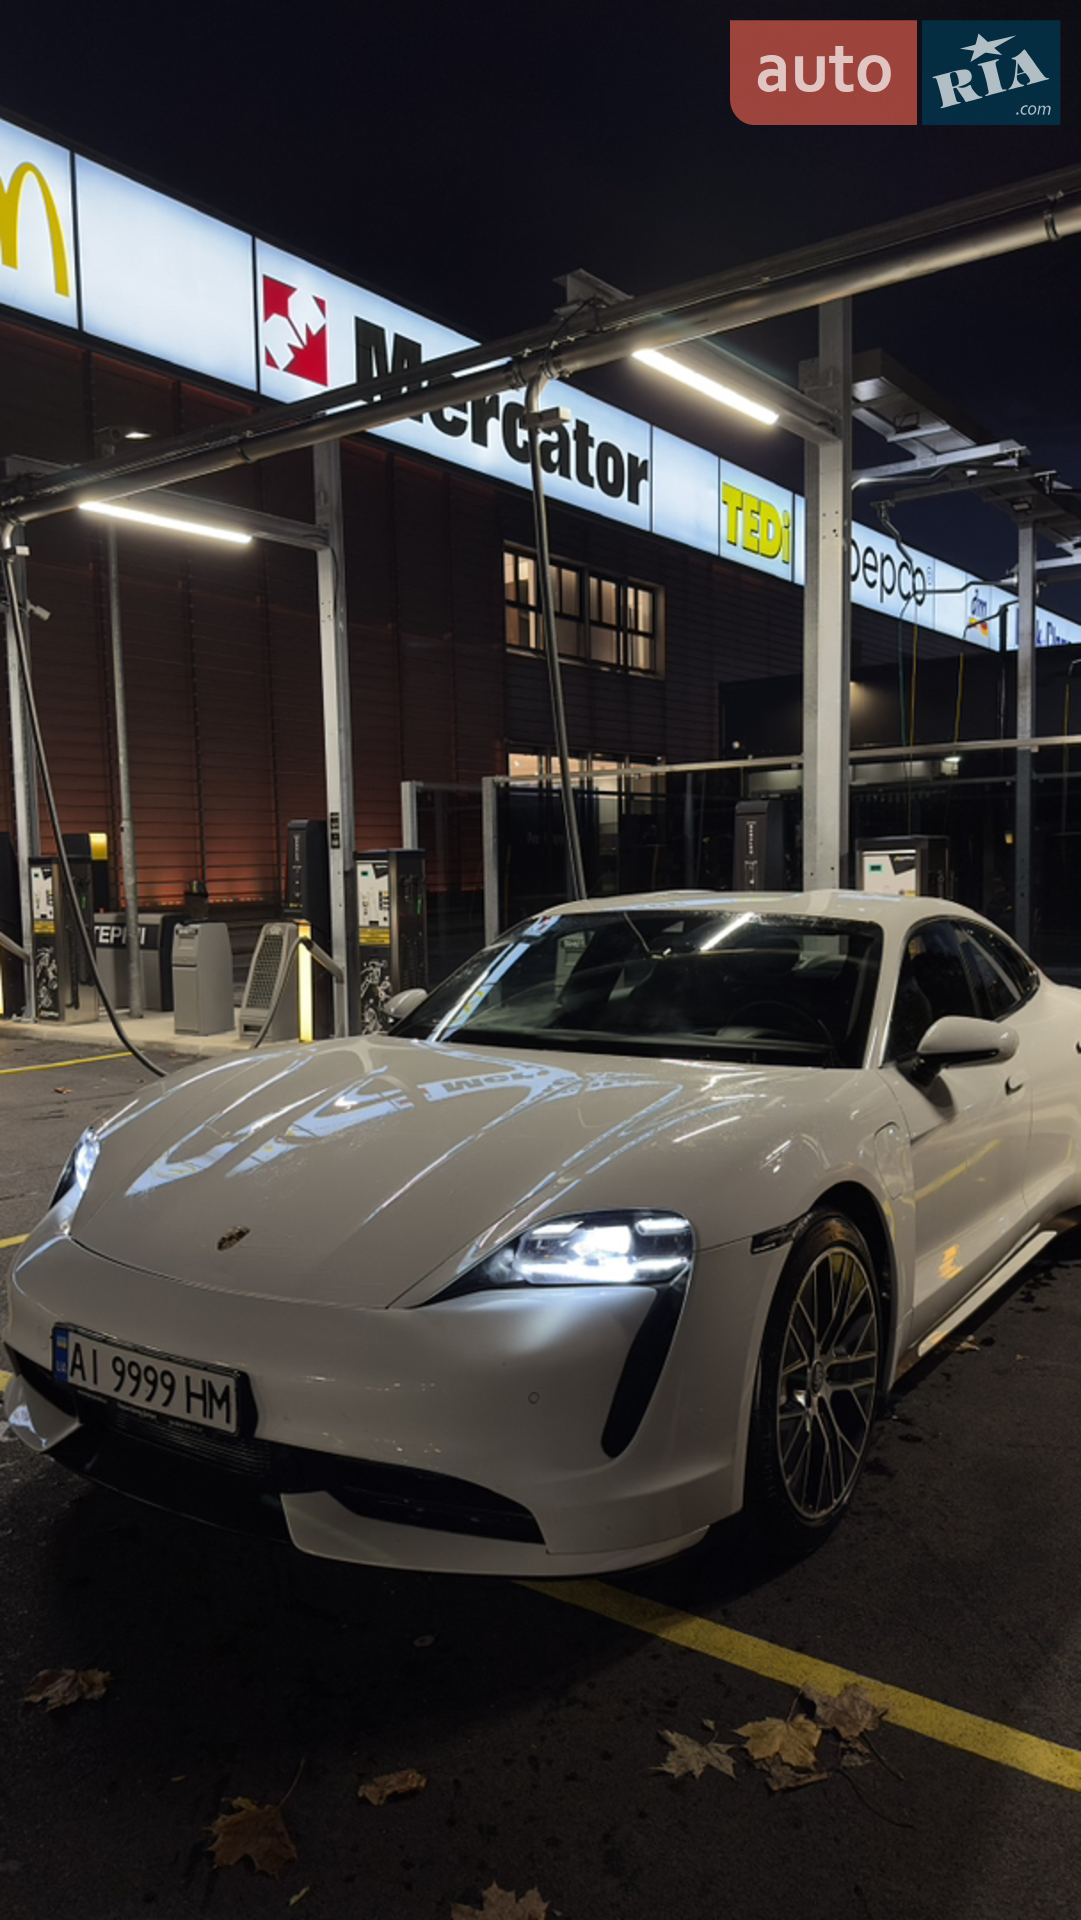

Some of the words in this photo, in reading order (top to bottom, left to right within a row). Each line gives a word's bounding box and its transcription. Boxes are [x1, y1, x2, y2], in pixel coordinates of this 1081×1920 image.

[721, 482, 792, 564] TEDi
[70, 1341, 98, 1385] AI
[112, 1356, 176, 1407] 9999
[185, 1375, 231, 1424] HM
